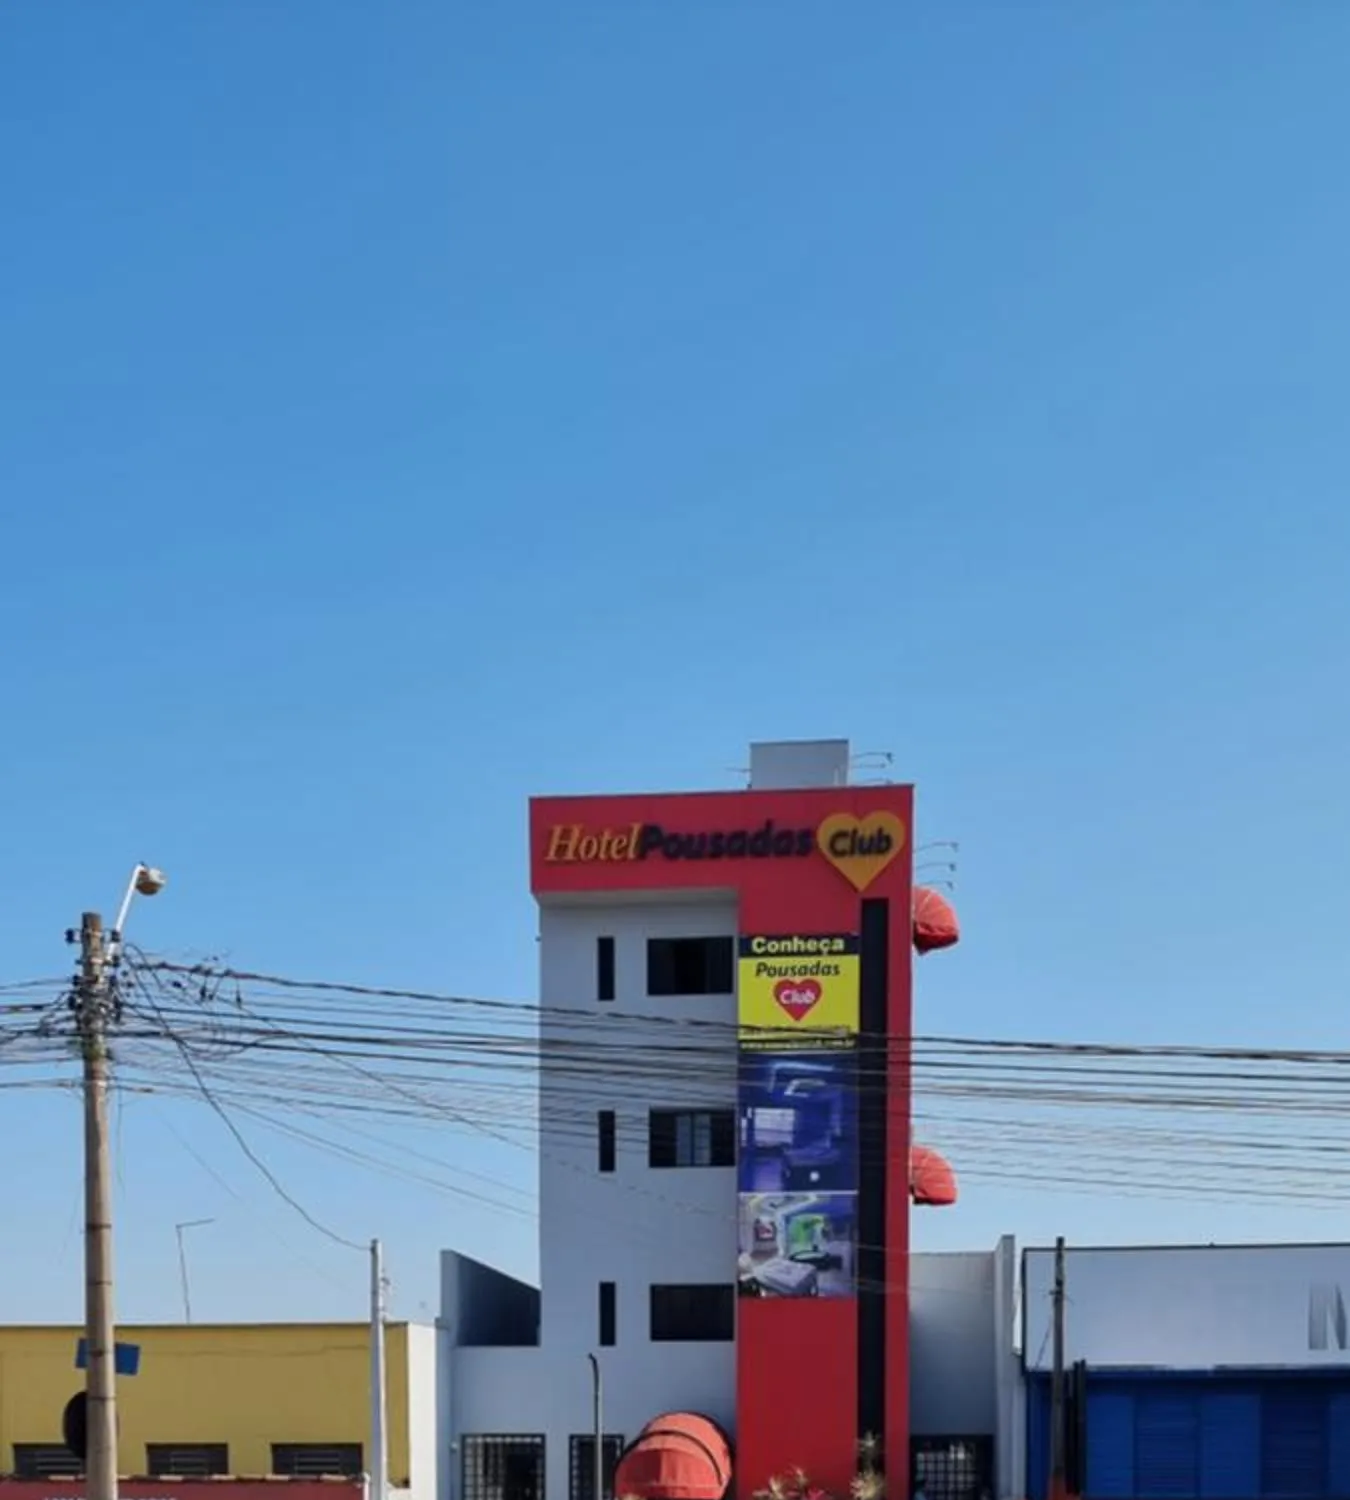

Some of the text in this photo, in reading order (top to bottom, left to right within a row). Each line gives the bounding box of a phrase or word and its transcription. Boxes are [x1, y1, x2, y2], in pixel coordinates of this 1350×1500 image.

[545, 822, 641, 861] Hotel
[828, 826, 893, 858] Club
[751, 935, 845, 955] Conheça
[755, 960, 840, 977] Pousadas
[780, 989, 816, 1004] Club
